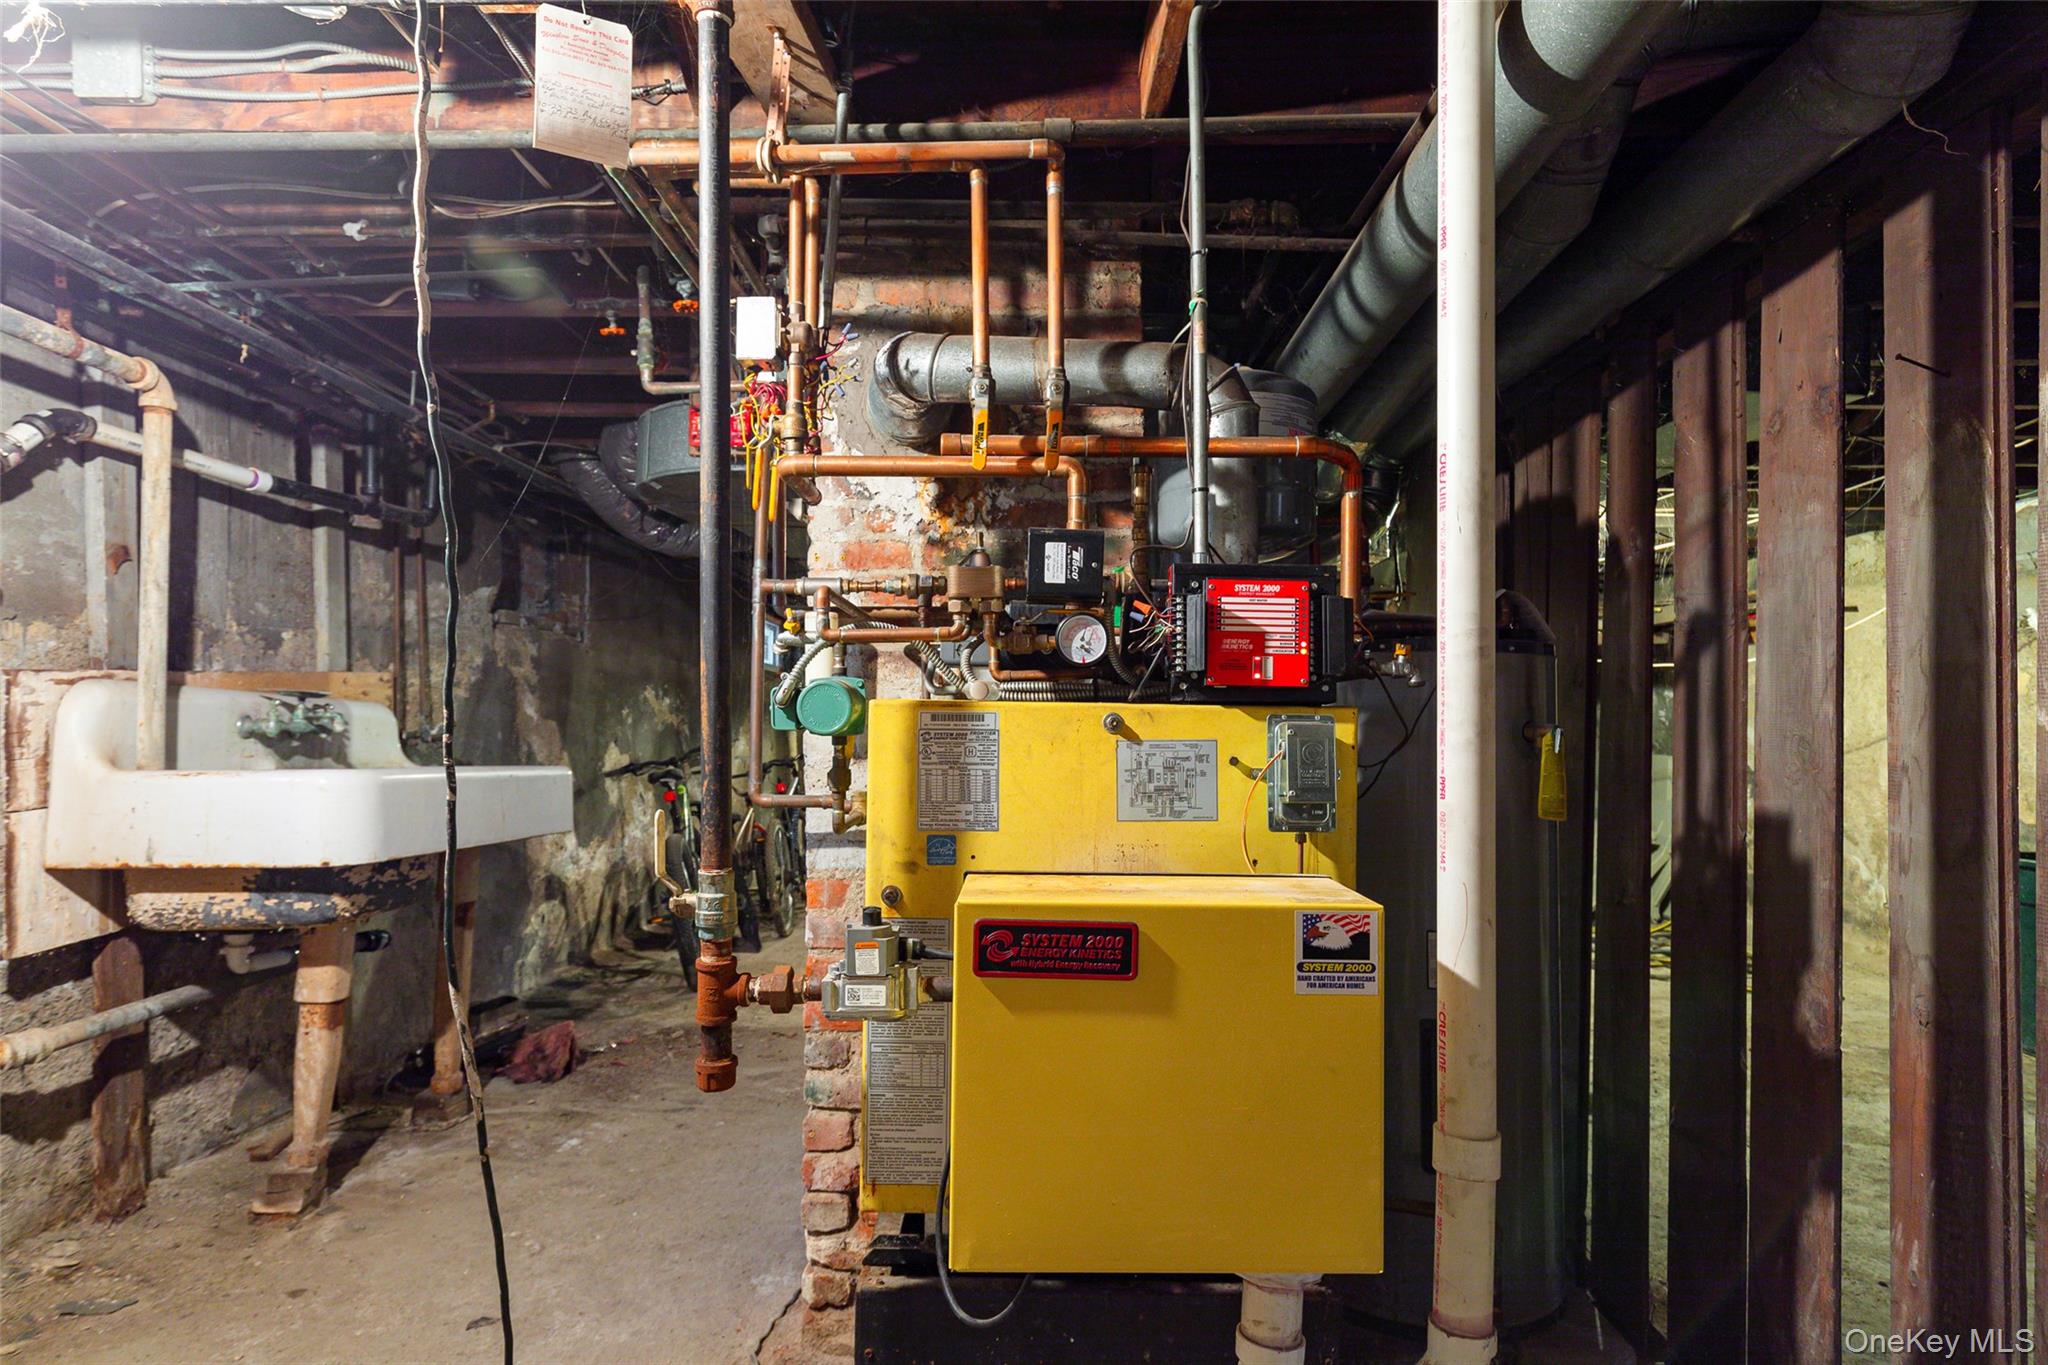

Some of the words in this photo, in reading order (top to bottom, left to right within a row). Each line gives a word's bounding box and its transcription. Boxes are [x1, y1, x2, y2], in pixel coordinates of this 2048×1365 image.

[555, 19, 568, 28] Not
[570, 23, 596, 36] Remove
[598, 31, 612, 41] This
[614, 36, 629, 46] Card
[1072, 546, 1083, 580] Taco
[1234, 584, 1261, 592] SYSTEM
[1262, 585, 1281, 593] 2000
[1021, 933, 1084, 948] SYSTEM
[1085, 935, 1125, 949] 2000
[1020, 946, 1068, 958] ENERGY
[1069, 948, 1122, 959] KINETICS
[1010, 960, 1029, 968] with
[1029, 960, 1055, 969] Hybrid
[1055, 961, 1083, 970] Energy
[1084, 962, 1120, 971] Recovery
[1303, 963, 1344, 972] SYSTEM
[1345, 963, 1373, 973] 2000
